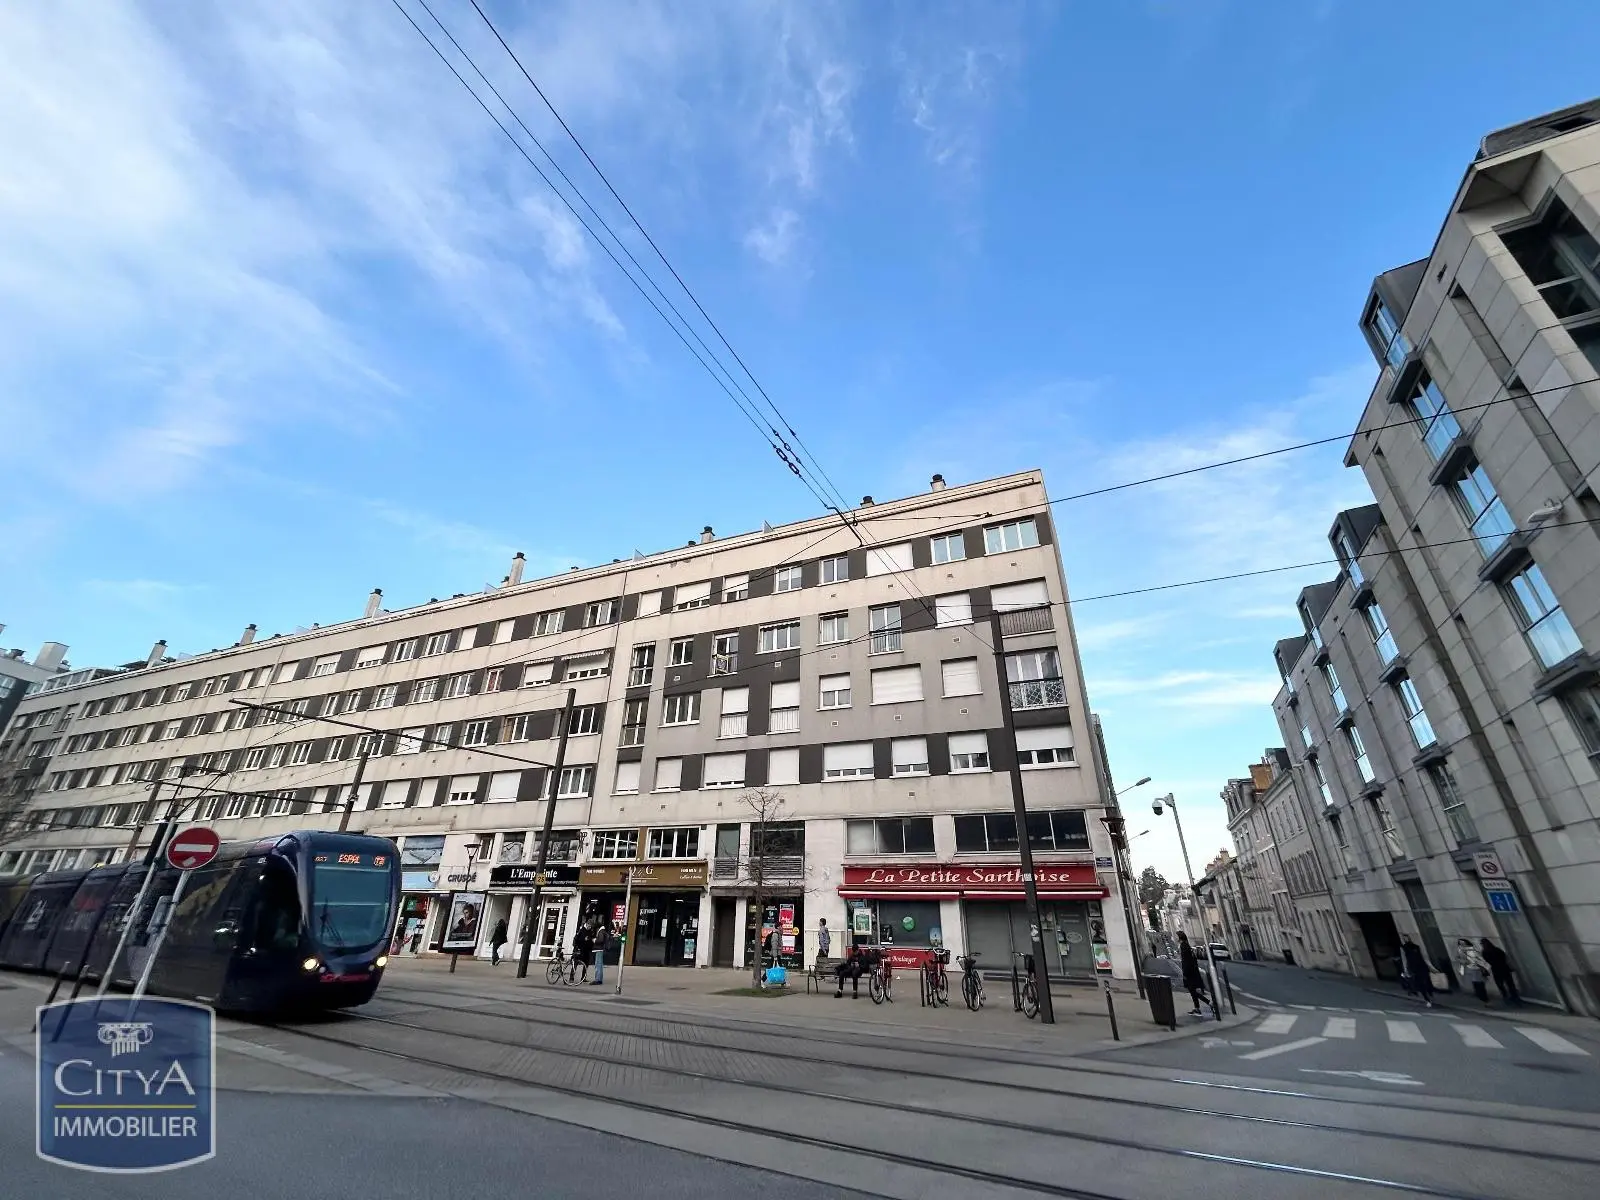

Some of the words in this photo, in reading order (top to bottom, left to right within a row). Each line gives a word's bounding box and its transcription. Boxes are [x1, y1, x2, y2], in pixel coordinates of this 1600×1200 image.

[864, 868, 895, 883] La
[899, 868, 961, 883] Petite
[966, 867, 1070, 883] Sarthise
